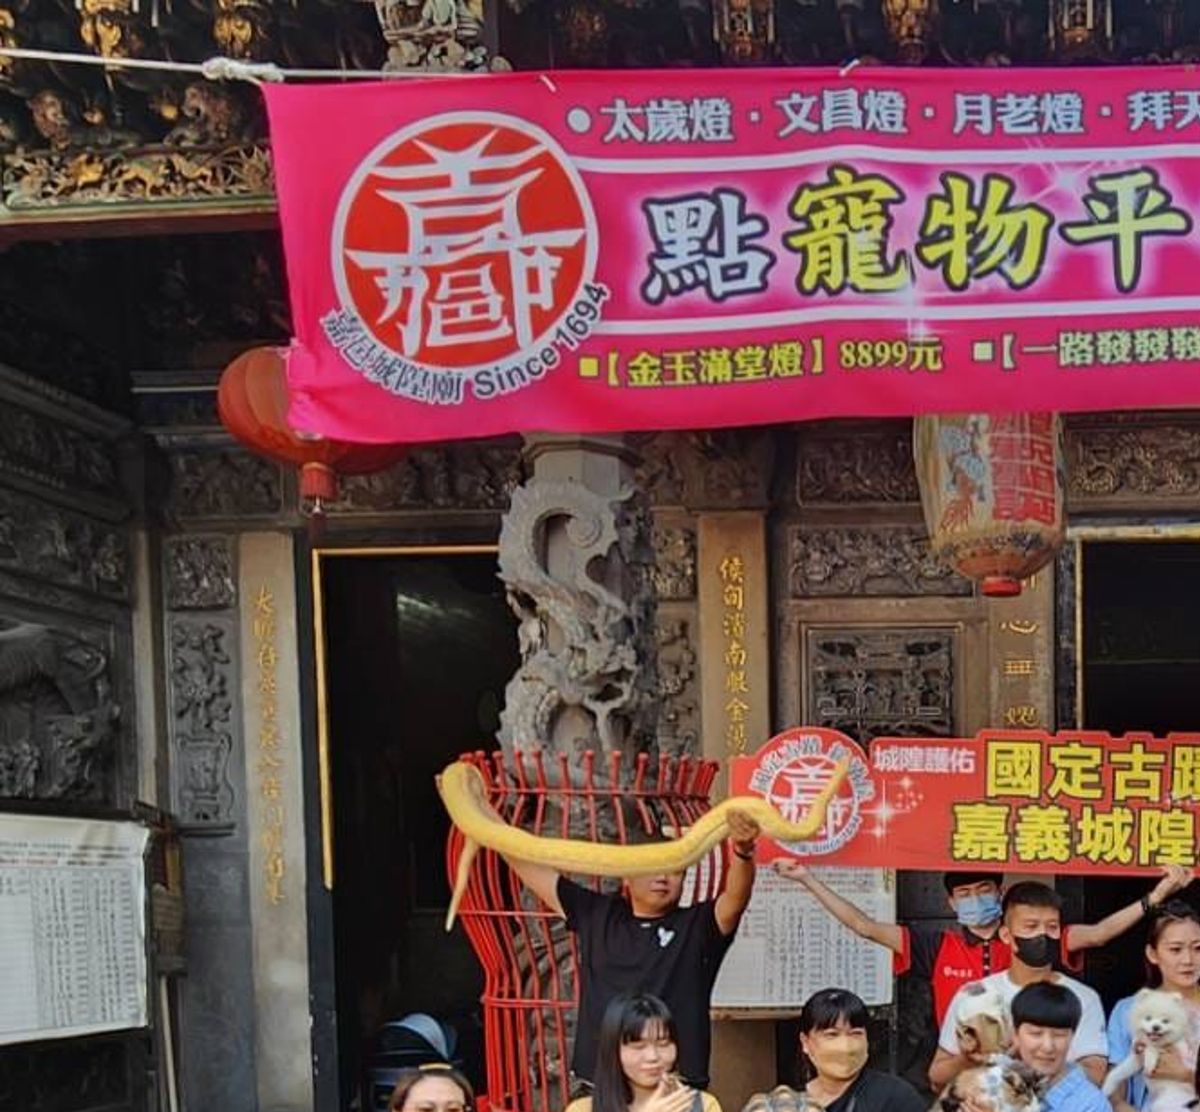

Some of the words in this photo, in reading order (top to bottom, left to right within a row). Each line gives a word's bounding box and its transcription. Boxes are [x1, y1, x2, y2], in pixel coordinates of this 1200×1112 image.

[600, 97, 736, 144] 太歲燈
[775, 88, 907, 135] 文昌燈
[953, 91, 1085, 136] 月老燈
[472, 345, 559, 398] Since
[555, 280, 611, 350] 1694
[839, 333, 944, 372] 8899元
[873, 745, 976, 773] 城隍護佑
